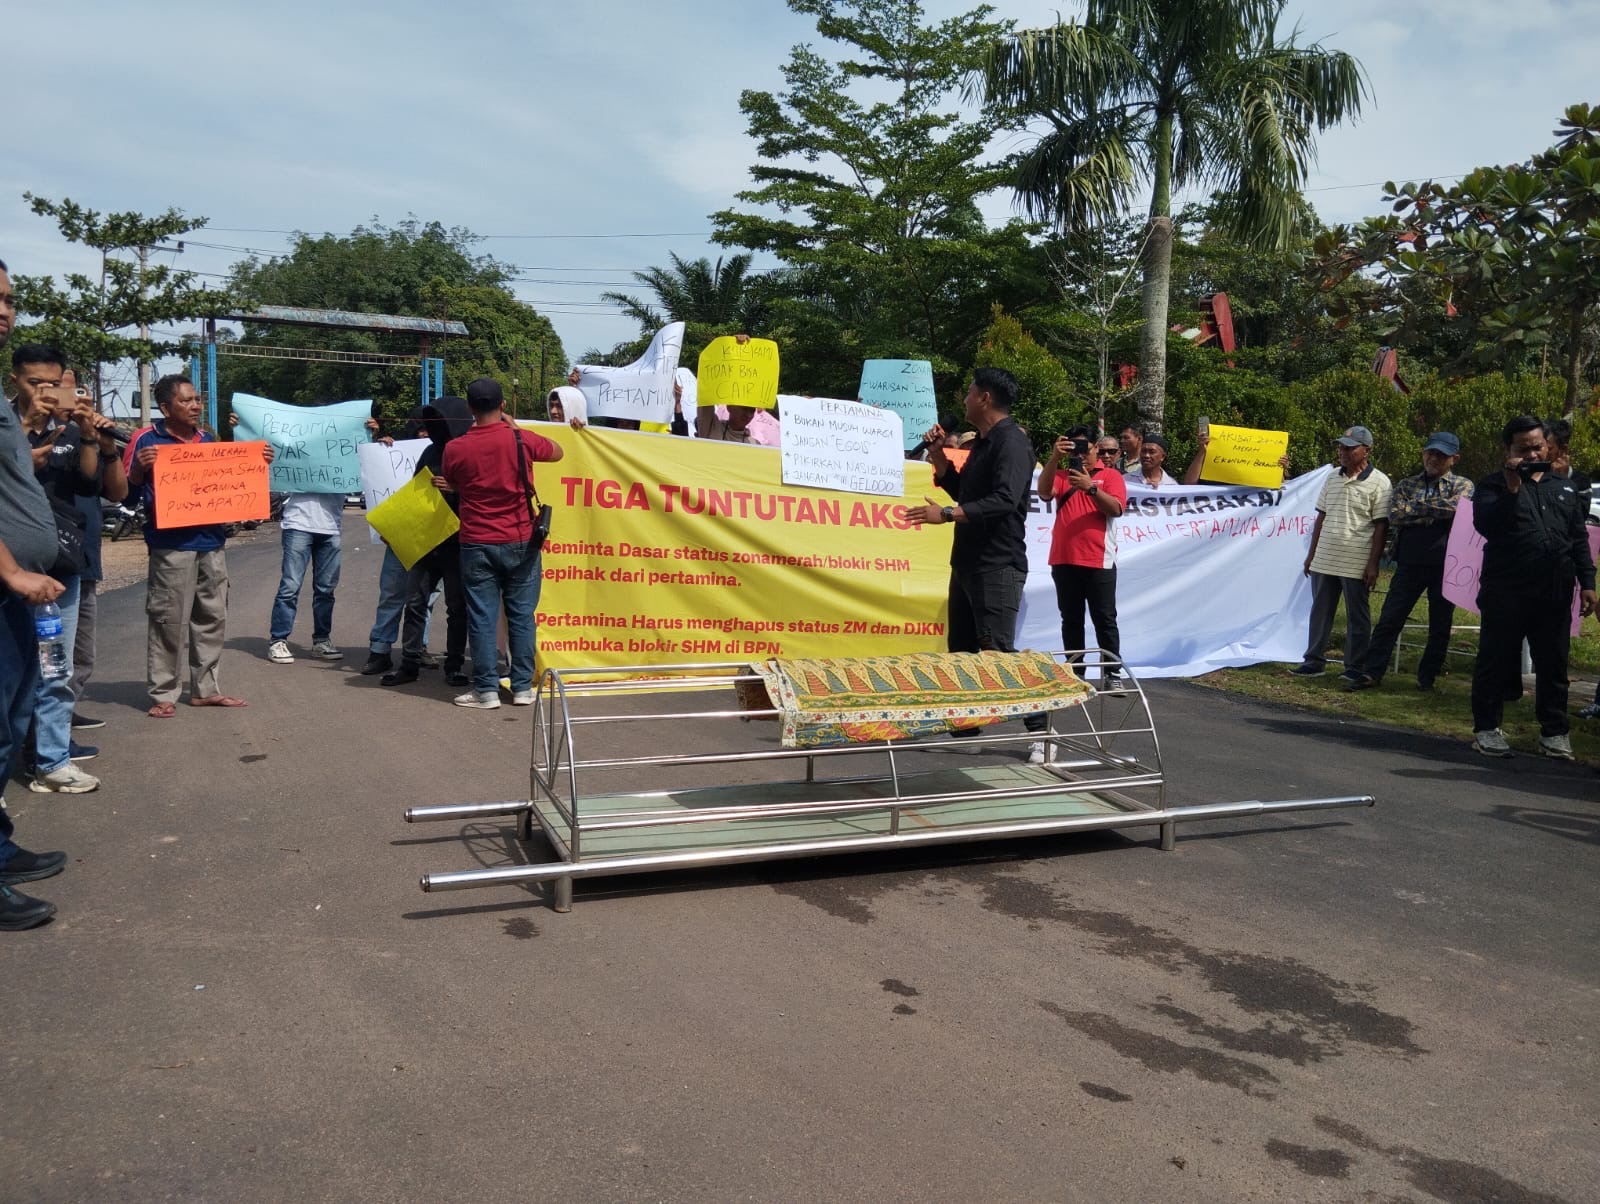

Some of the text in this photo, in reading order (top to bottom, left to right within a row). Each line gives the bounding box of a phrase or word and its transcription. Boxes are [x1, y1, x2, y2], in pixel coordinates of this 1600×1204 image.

[704, 364, 758, 380] TIDAK BISA
[598, 381, 674, 407] PERTAMIN
[820, 400, 884, 418] PERTAMINA
[262, 413, 338, 439] PERCUMA
[794, 414, 825, 428] BUKAN
[829, 420, 859, 433] MUSUH
[271, 441, 311, 460] YAR
[792, 434, 829, 449] JANGAN
[170, 447, 248, 462] ZONA MERAH
[793, 453, 841, 470] PIKIRKAN
[846, 461, 877, 477] NASIB
[159, 463, 266, 487] KAMI PUNYA SHM
[272, 464, 333, 485] RTIFIKAT
[793, 471, 829, 484] JANGAN
[190, 481, 246, 495] PERTAMINA
[167, 500, 202, 518] PUNYA
[560, 476, 923, 532] TIGA TUNTUTAN AKS
[1124, 486, 1286, 518] ASYARAKAT
[1166, 517, 1261, 539] PERTAMINA
[618, 542, 671, 560] Dasar
[673, 545, 729, 562] status
[732, 551, 872, 571] zonamerah/blokir
[874, 557, 911, 572] SHM
[609, 567, 645, 584] dari
[648, 569, 742, 588] pertamina.
[535, 612, 945, 636] Pertamina Harus menghapus status ZM dan DJKN
[540, 636, 785, 656] membuka blokir SHM di BPN.
